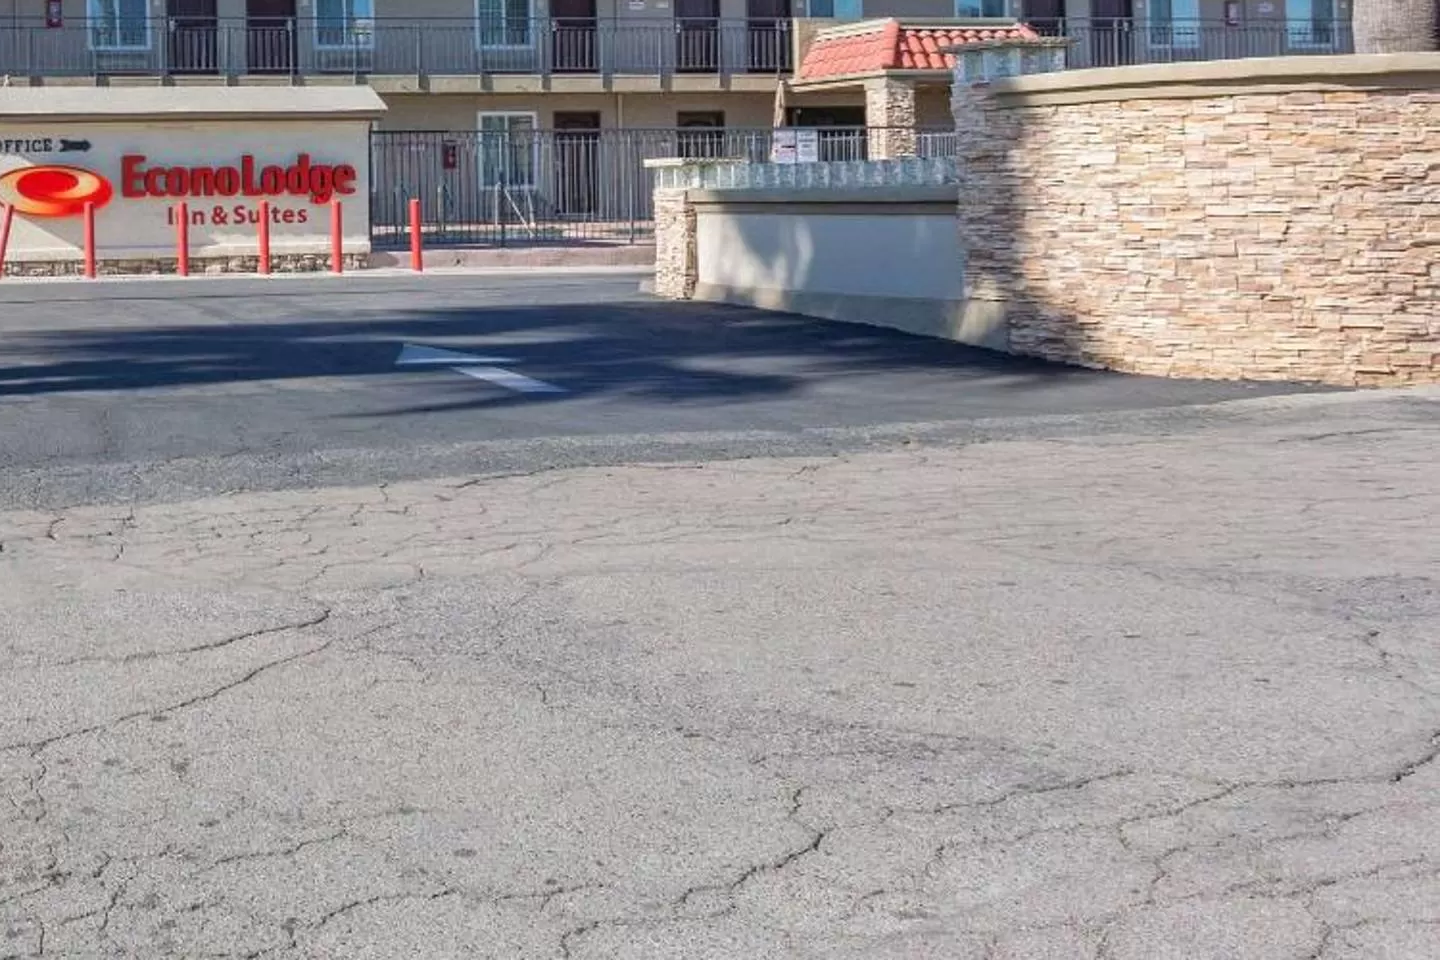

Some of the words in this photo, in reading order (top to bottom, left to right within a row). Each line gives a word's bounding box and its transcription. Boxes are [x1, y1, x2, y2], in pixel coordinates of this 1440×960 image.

[120, 152, 357, 205] EconoLodge
[168, 206, 205, 225] In
[211, 205, 228, 225] &
[233, 204, 308, 224] Sutes
